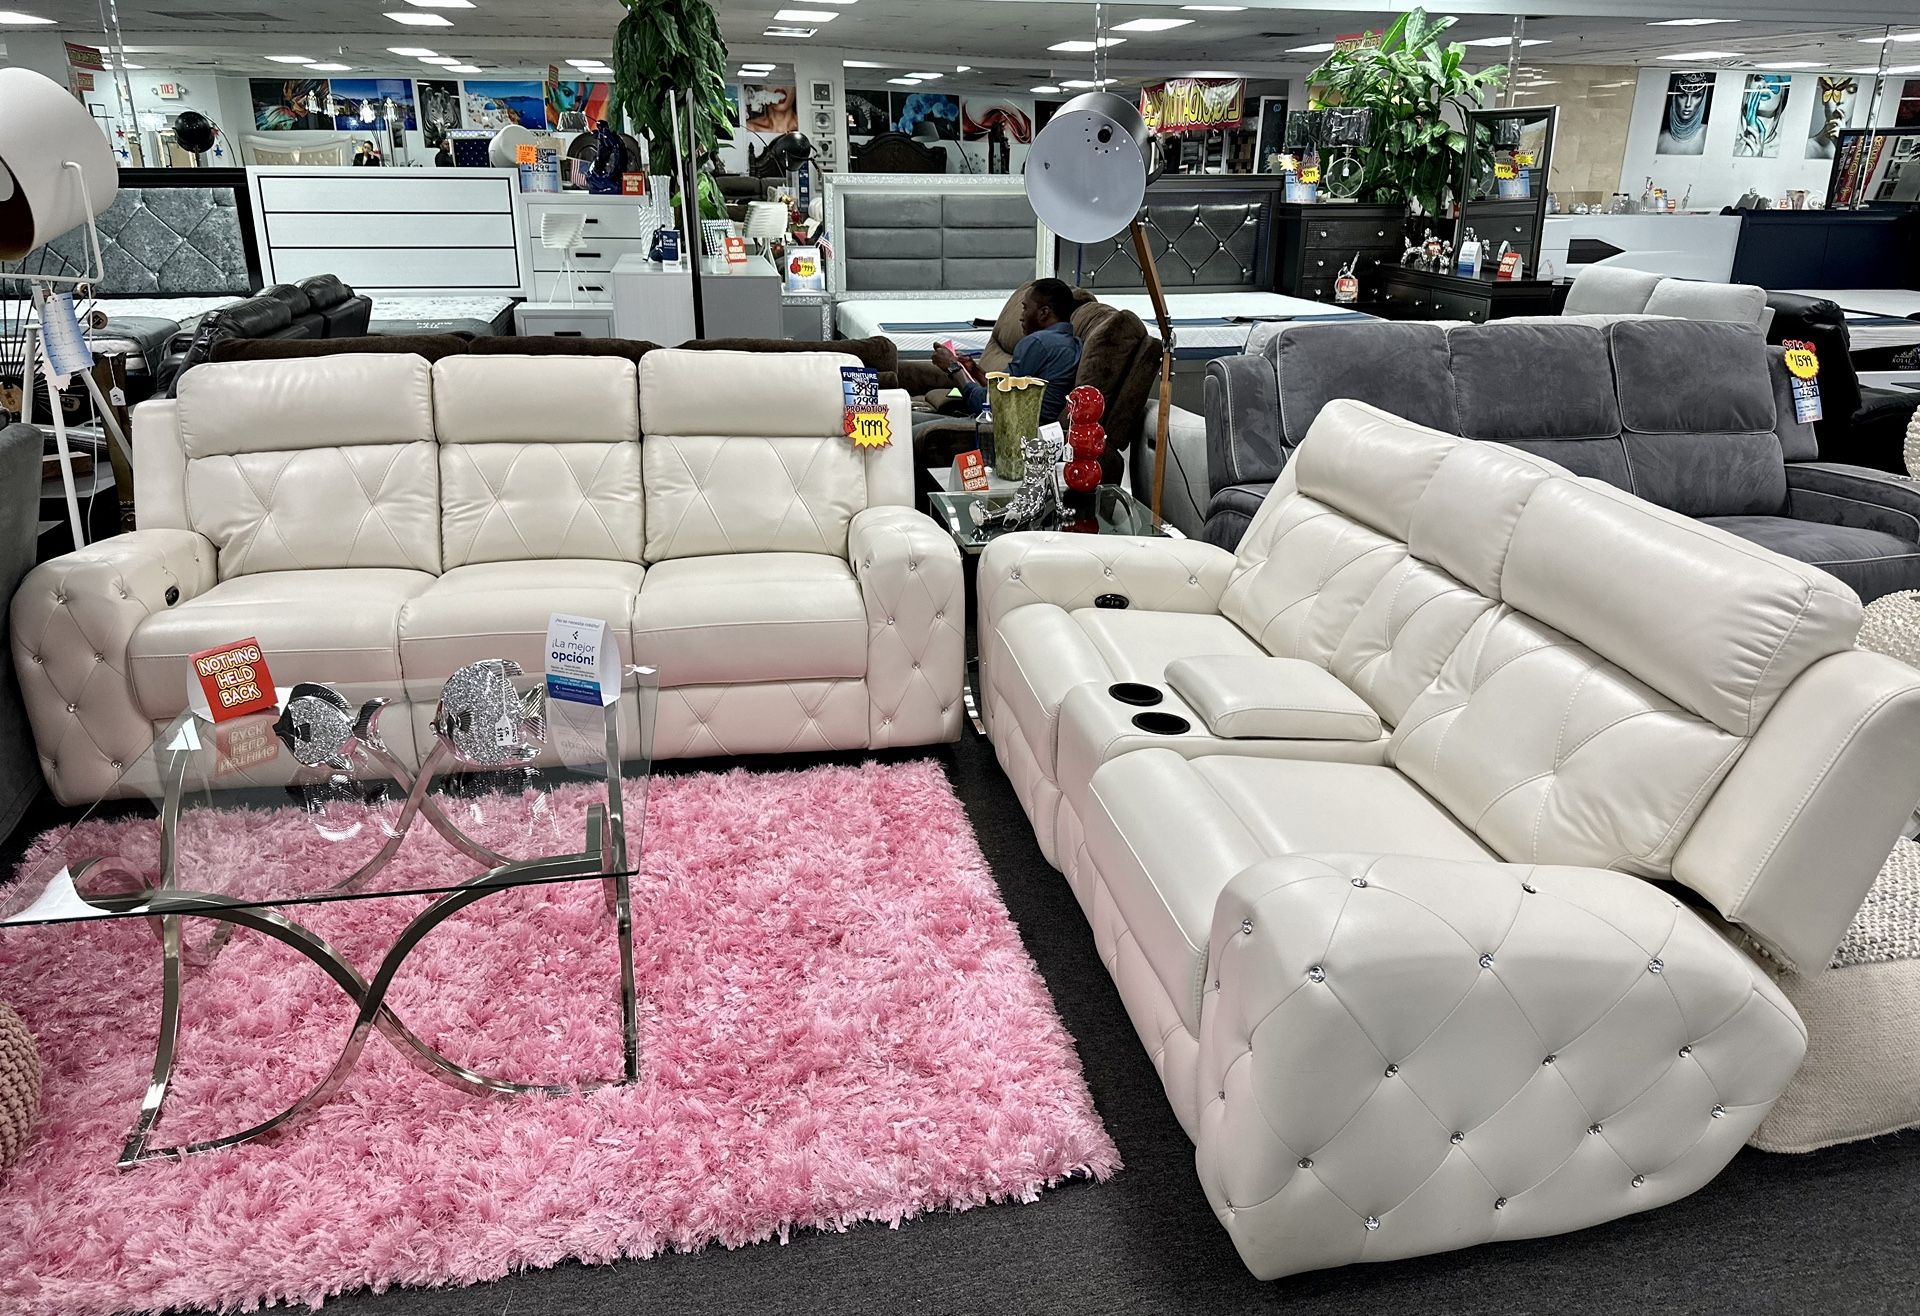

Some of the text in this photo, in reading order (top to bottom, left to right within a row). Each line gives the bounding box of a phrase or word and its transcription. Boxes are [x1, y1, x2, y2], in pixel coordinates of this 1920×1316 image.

[966, 454, 977, 467] NO
[963, 464, 983, 480] CREDIT
[551, 638, 595, 653] ¡La mejor
[198, 646, 260, 675] NOTHING
[551, 651, 594, 666] opción!
[216, 666, 254, 689] HELD
[221, 684, 260, 706] BACK
